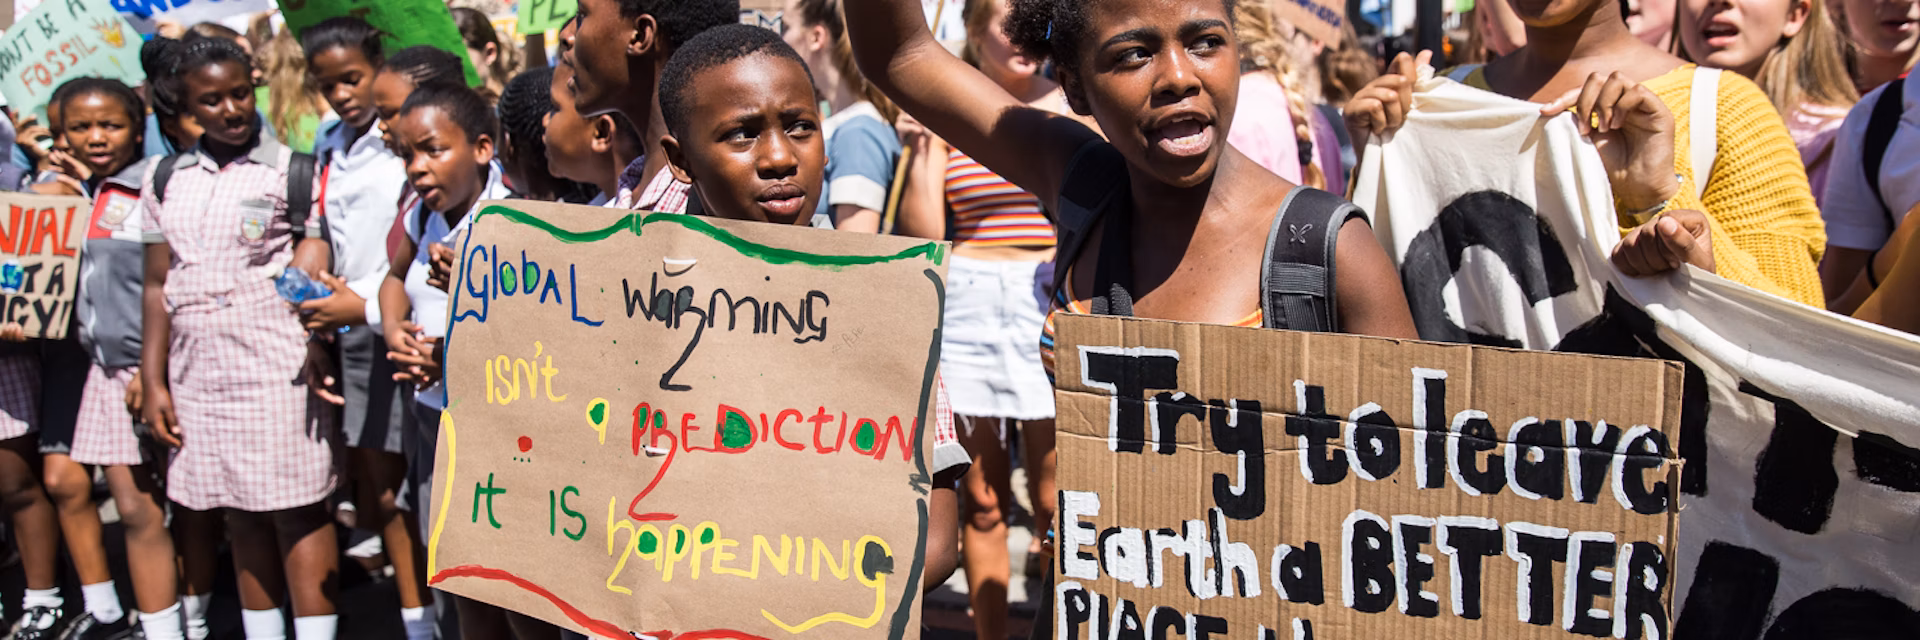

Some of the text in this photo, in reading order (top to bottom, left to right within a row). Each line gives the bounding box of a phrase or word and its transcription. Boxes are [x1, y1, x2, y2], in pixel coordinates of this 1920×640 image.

[36, 13, 59, 40] BE
[20, 34, 98, 96] FOSSIL
[44, 263, 65, 296] A
[1076, 345, 1266, 520] Try
[1285, 379, 1401, 485] to
[1411, 367, 1669, 515] leave
[1058, 490, 1261, 600] Earth
[1270, 541, 1325, 606] a
[1341, 509, 1669, 640] BETTER
